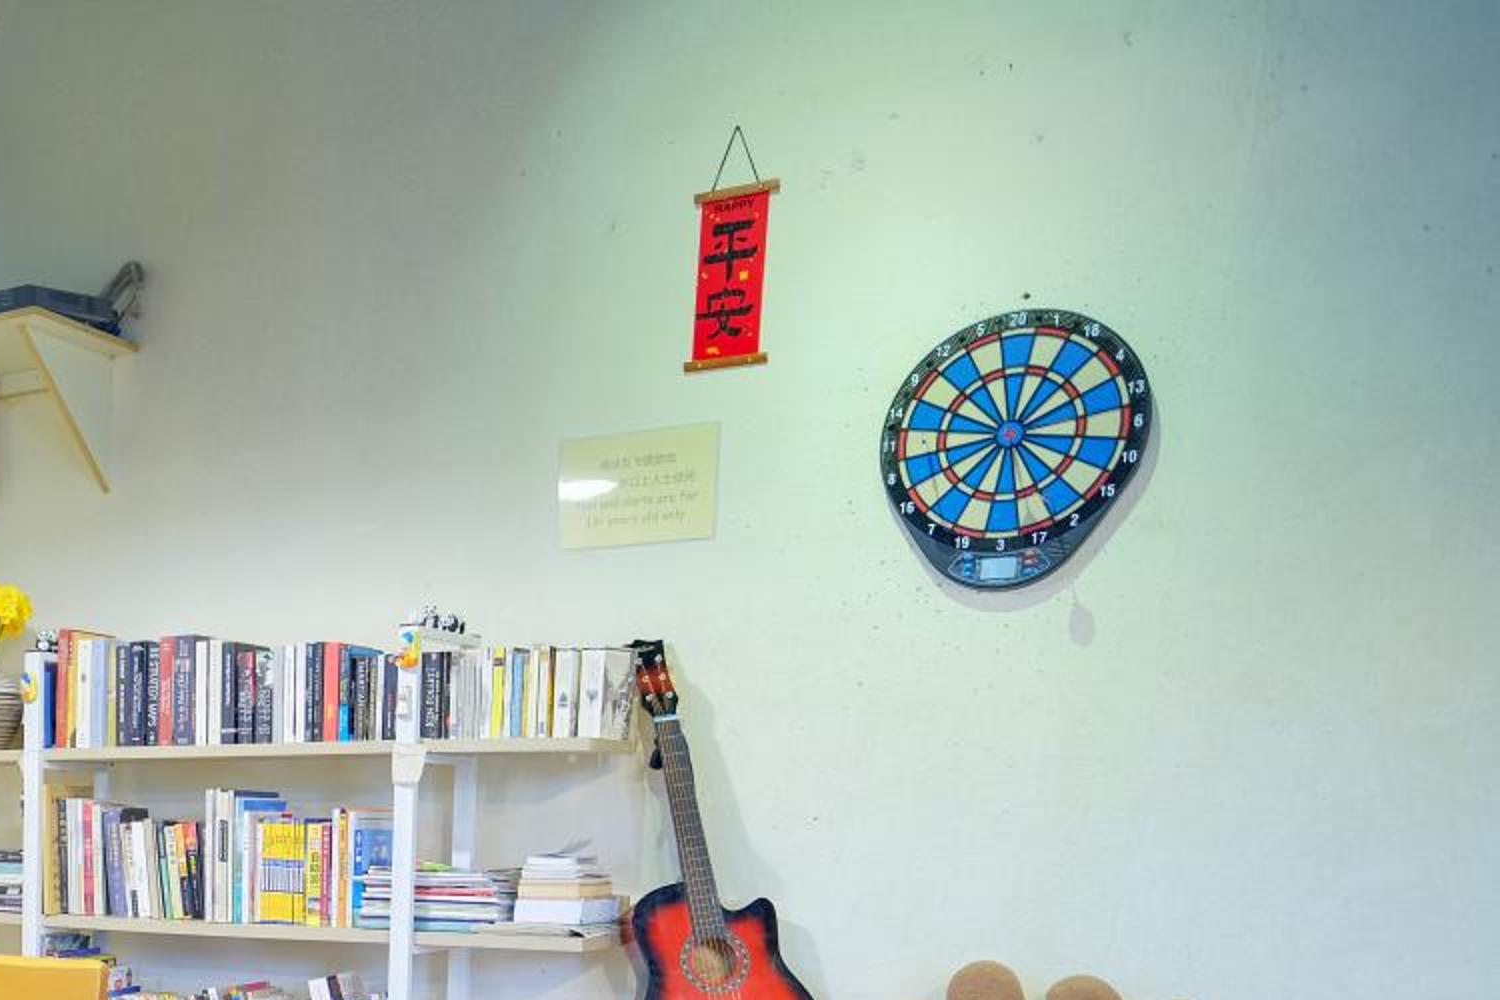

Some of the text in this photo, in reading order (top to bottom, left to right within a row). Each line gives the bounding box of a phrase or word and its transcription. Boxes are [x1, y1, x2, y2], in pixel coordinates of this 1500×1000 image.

[714, 199, 755, 213] HAPPY
[695, 220, 758, 339] 平安
[1010, 313, 1027, 326] 20
[1054, 314, 1060, 326] 1
[976, 324, 985, 336] 5
[1084, 325, 1100, 337] 18
[935, 345, 950, 358] 12
[1116, 349, 1125, 361] 4
[910, 374, 919, 386] 9
[1128, 380, 1145, 393] 13
[890, 408, 904, 420] 14
[1133, 414, 1144, 427] 6
[1122, 451, 1138, 463] 10
[886, 473, 896, 485] 8
[1100, 484, 1115, 497] 15
[900, 502, 915, 514] 16
[1069, 513, 1079, 527] 2
[927, 524, 936, 536] 7
[954, 537, 970, 549] 19
[1032, 531, 1047, 544] 17
[996, 539, 1005, 551] 3
